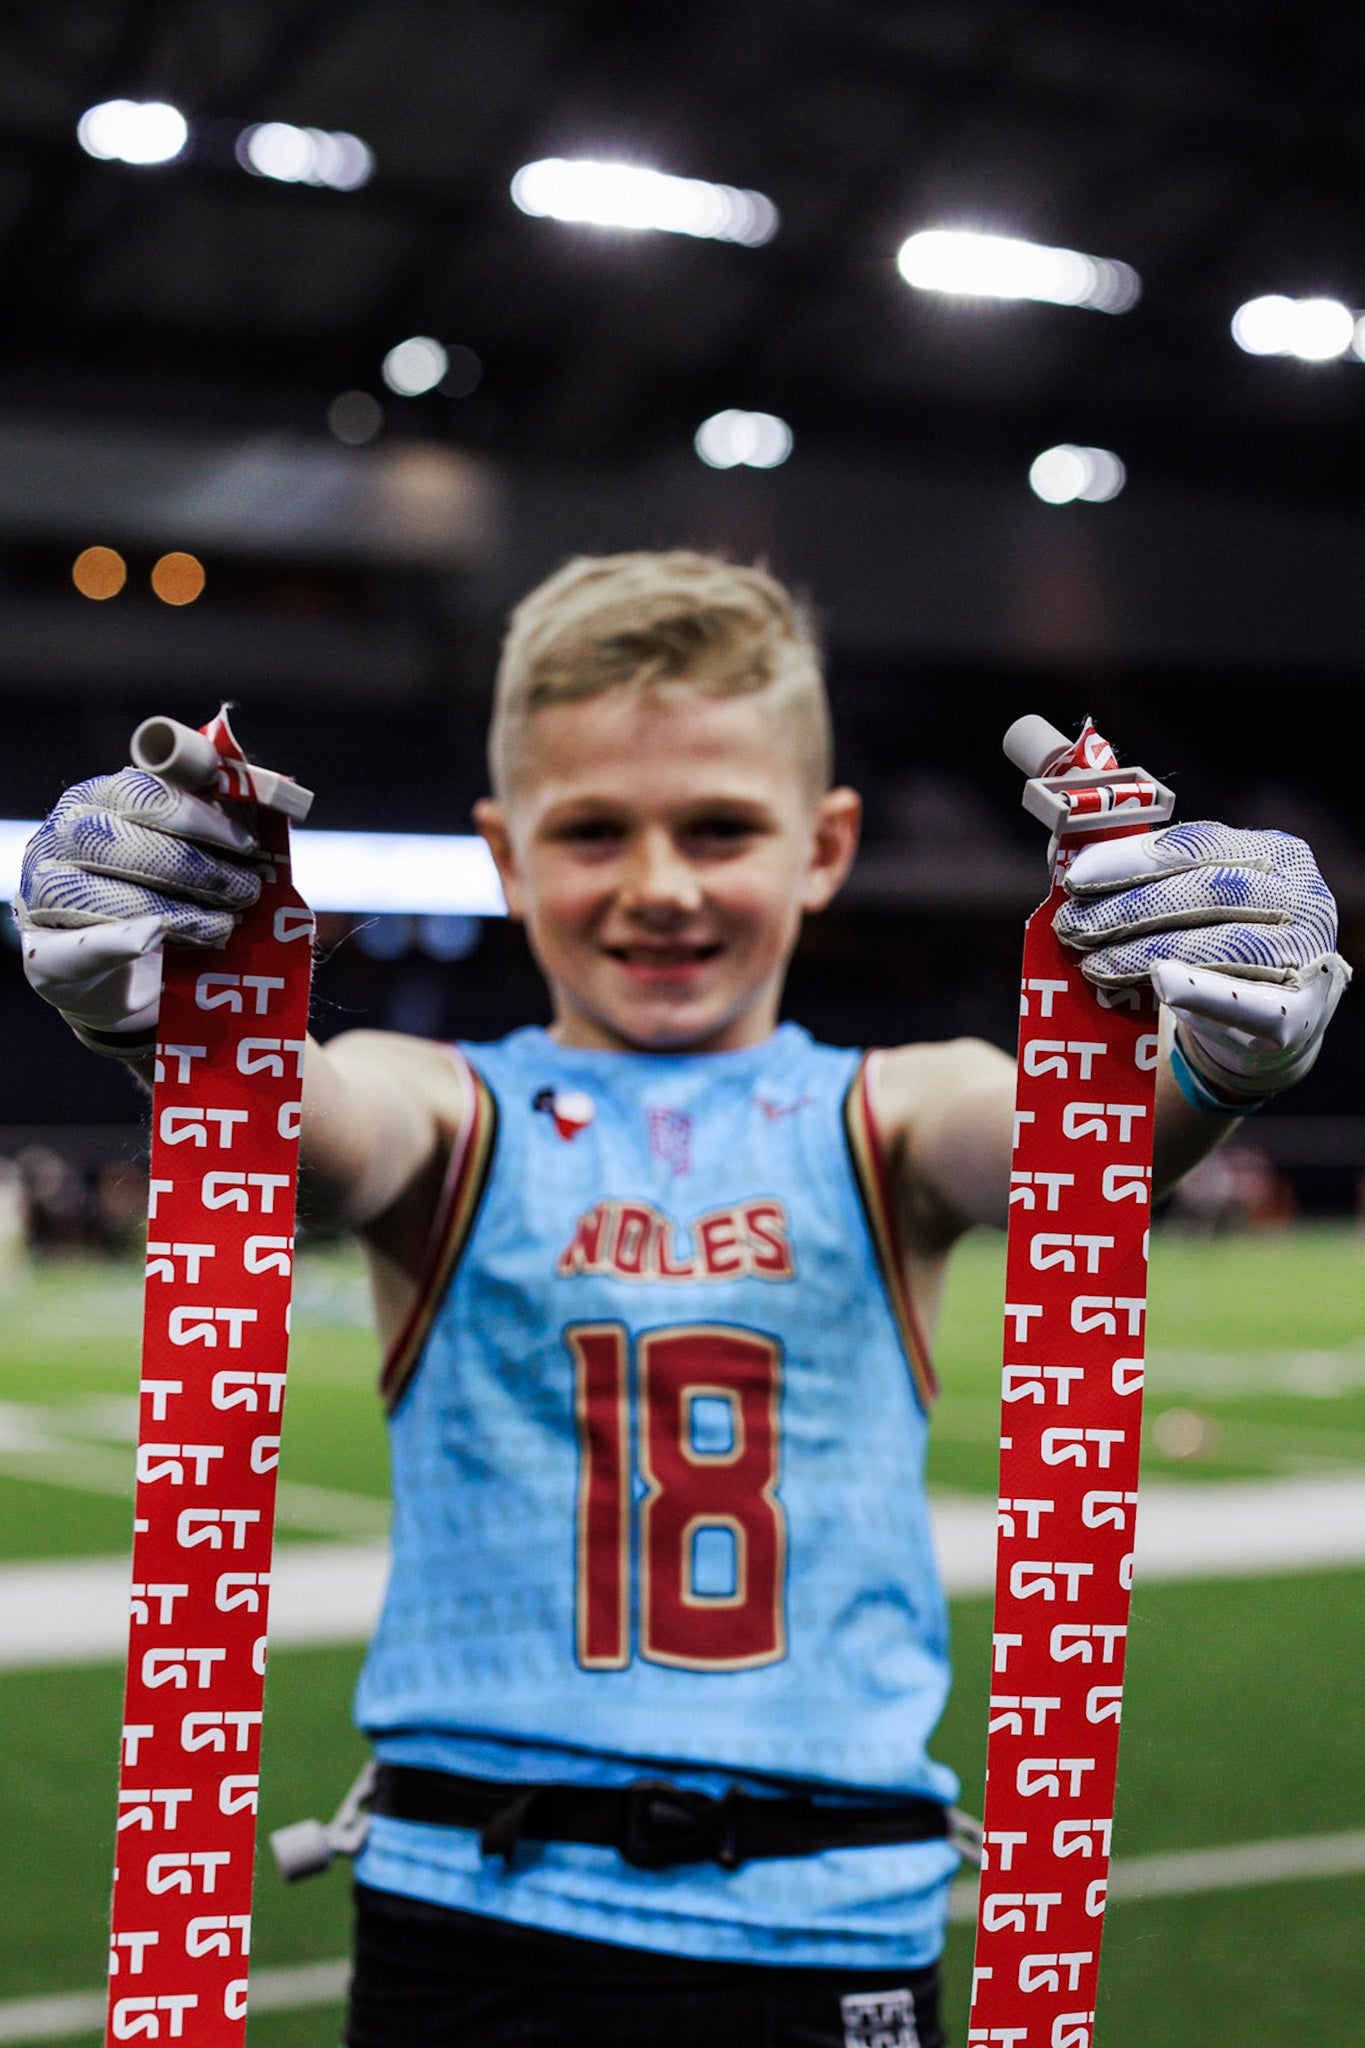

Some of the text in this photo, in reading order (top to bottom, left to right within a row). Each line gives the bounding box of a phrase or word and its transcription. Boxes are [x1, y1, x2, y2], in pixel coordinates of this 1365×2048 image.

[273, 906, 315, 943] G
[1020, 979, 1068, 1017] T
[155, 1045, 206, 1083] T
[1102, 1165, 1153, 1204] G
[244, 1235, 294, 1276] G
[557, 1197, 796, 1281] NOLES
[1004, 1304, 1042, 1342] T
[140, 1380, 182, 1420] T
[565, 1322, 789, 1671] 18
[1082, 1491, 1137, 1531] G
[215, 1572, 272, 1612] G
[993, 1633, 1022, 1672] T
[1086, 1686, 1123, 1723] G
[121, 1725, 154, 1766] T
[219, 1775, 258, 1815] G
[982, 1832, 1027, 1870] T
[110, 1931, 160, 1975] T
[1051, 2011, 1095, 2048] G
